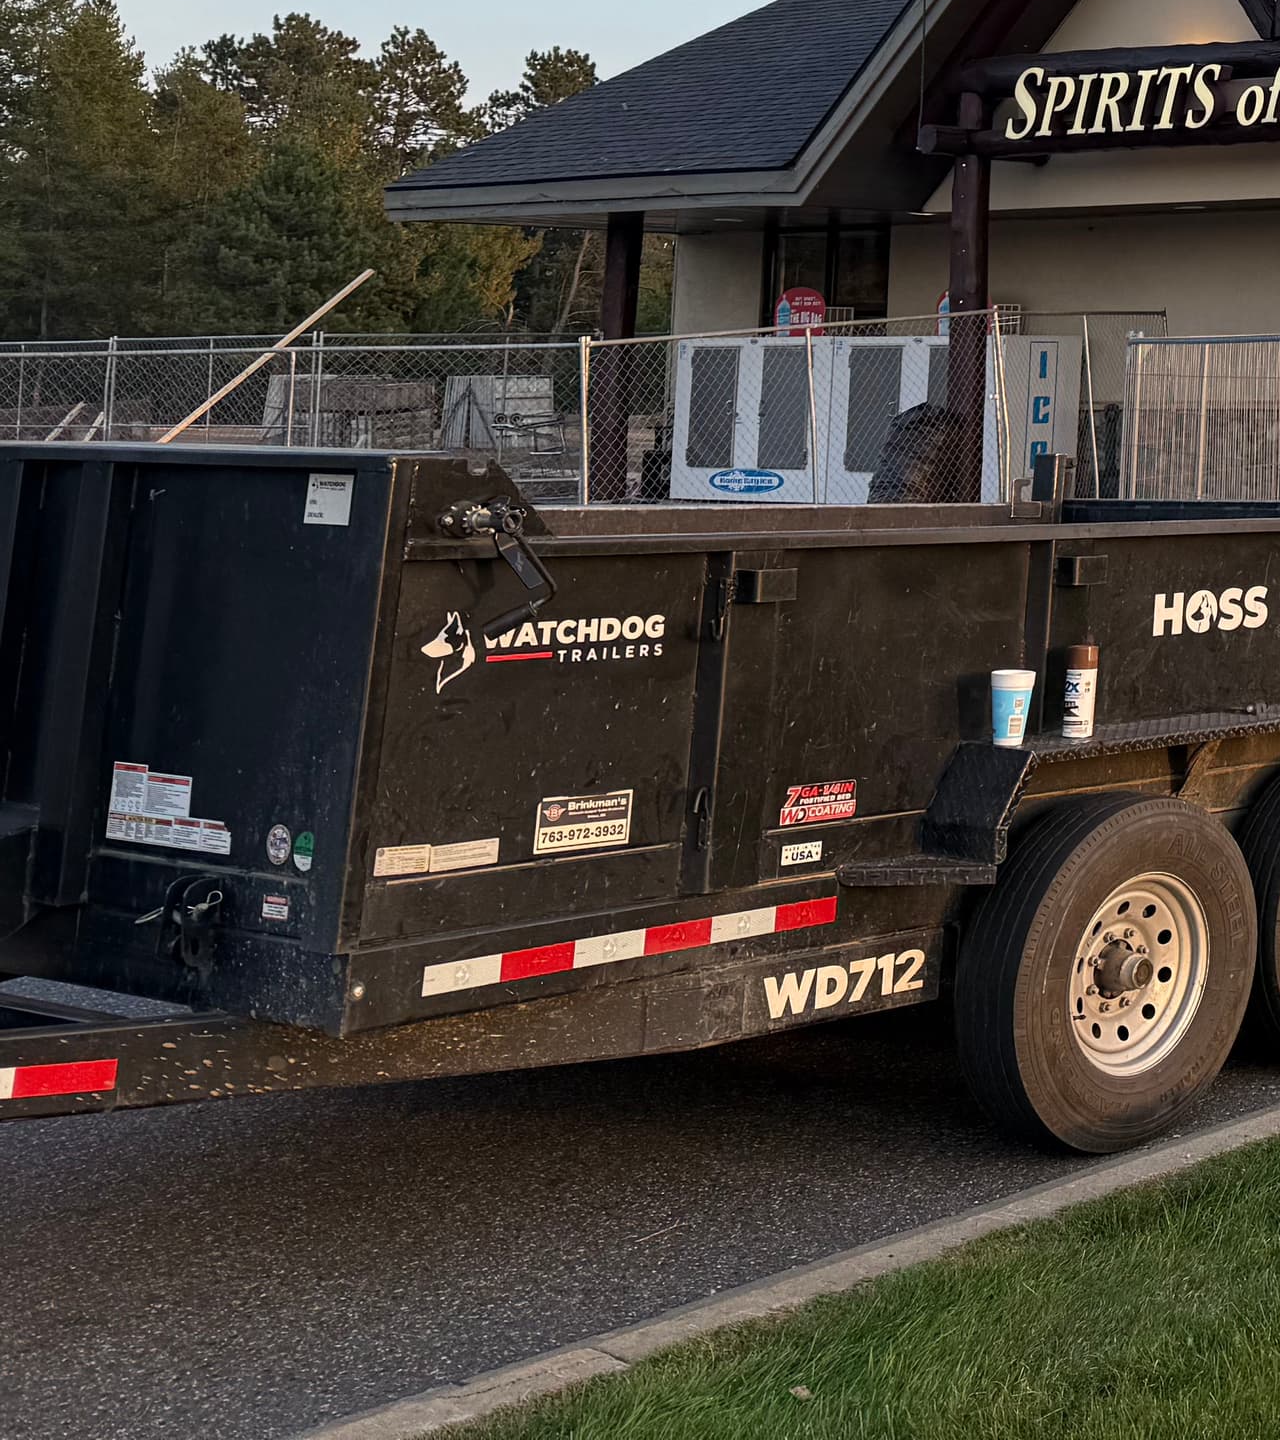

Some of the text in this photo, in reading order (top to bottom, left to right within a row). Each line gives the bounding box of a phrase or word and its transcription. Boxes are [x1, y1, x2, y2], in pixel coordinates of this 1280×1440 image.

[1004, 63, 1221, 140] SPIRITS
[1152, 585, 1268, 636] HOSS
[557, 644, 664, 663] TRAILERS
[567, 797, 627, 811] Brinkman's
[808, 802, 854, 817] COATING
[541, 823, 624, 844] 763-972-3932
[791, 850, 814, 861] USA
[763, 949, 926, 1020] WD712
